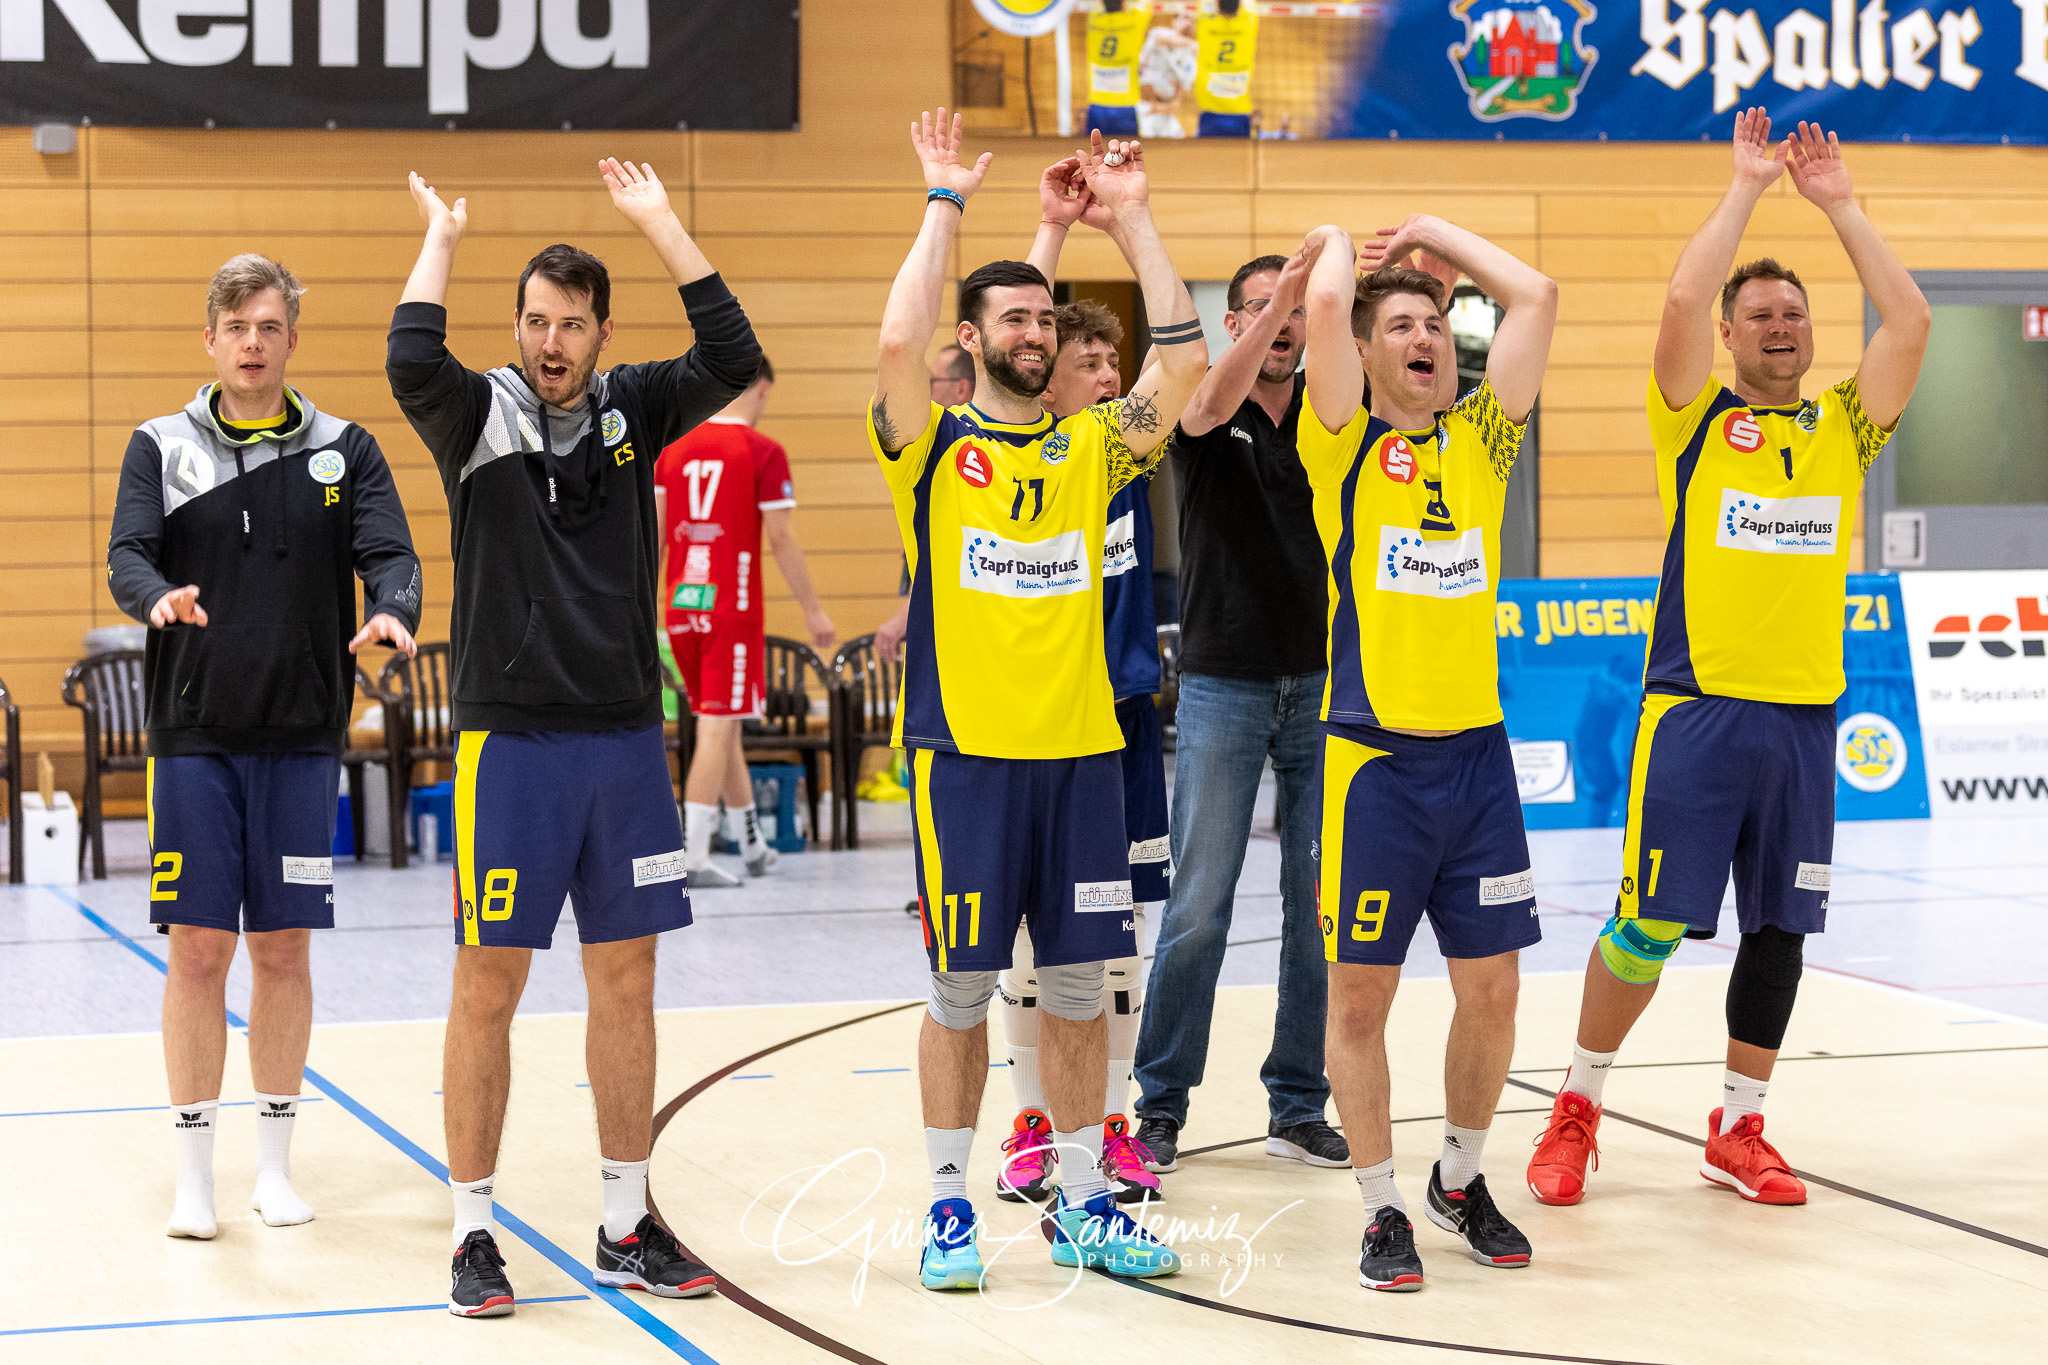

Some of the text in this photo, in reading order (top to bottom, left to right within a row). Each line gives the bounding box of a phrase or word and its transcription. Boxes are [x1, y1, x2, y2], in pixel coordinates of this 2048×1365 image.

[1630, 0, 1983, 114] Spalter
[613, 442, 635, 466] CS
[1230, 426, 1253, 445] Kemp
[1779, 446, 1794, 481] 1
[324, 486, 340, 507] JS
[549, 477, 558, 502] Kempa
[683, 459, 724, 520] 17
[1740, 516, 1832, 536] Zapf Daigfuss
[979, 556, 1014, 576] Zapf
[1496, 594, 1892, 645] R JUGEN Z!
[150, 852, 183, 901] 2
[1647, 848, 1664, 897] 1
[481, 868, 518, 922] 8
[1351, 890, 1391, 942] 9
[944, 891, 982, 949] 11
[1591, 1061, 1612, 1069] adid
